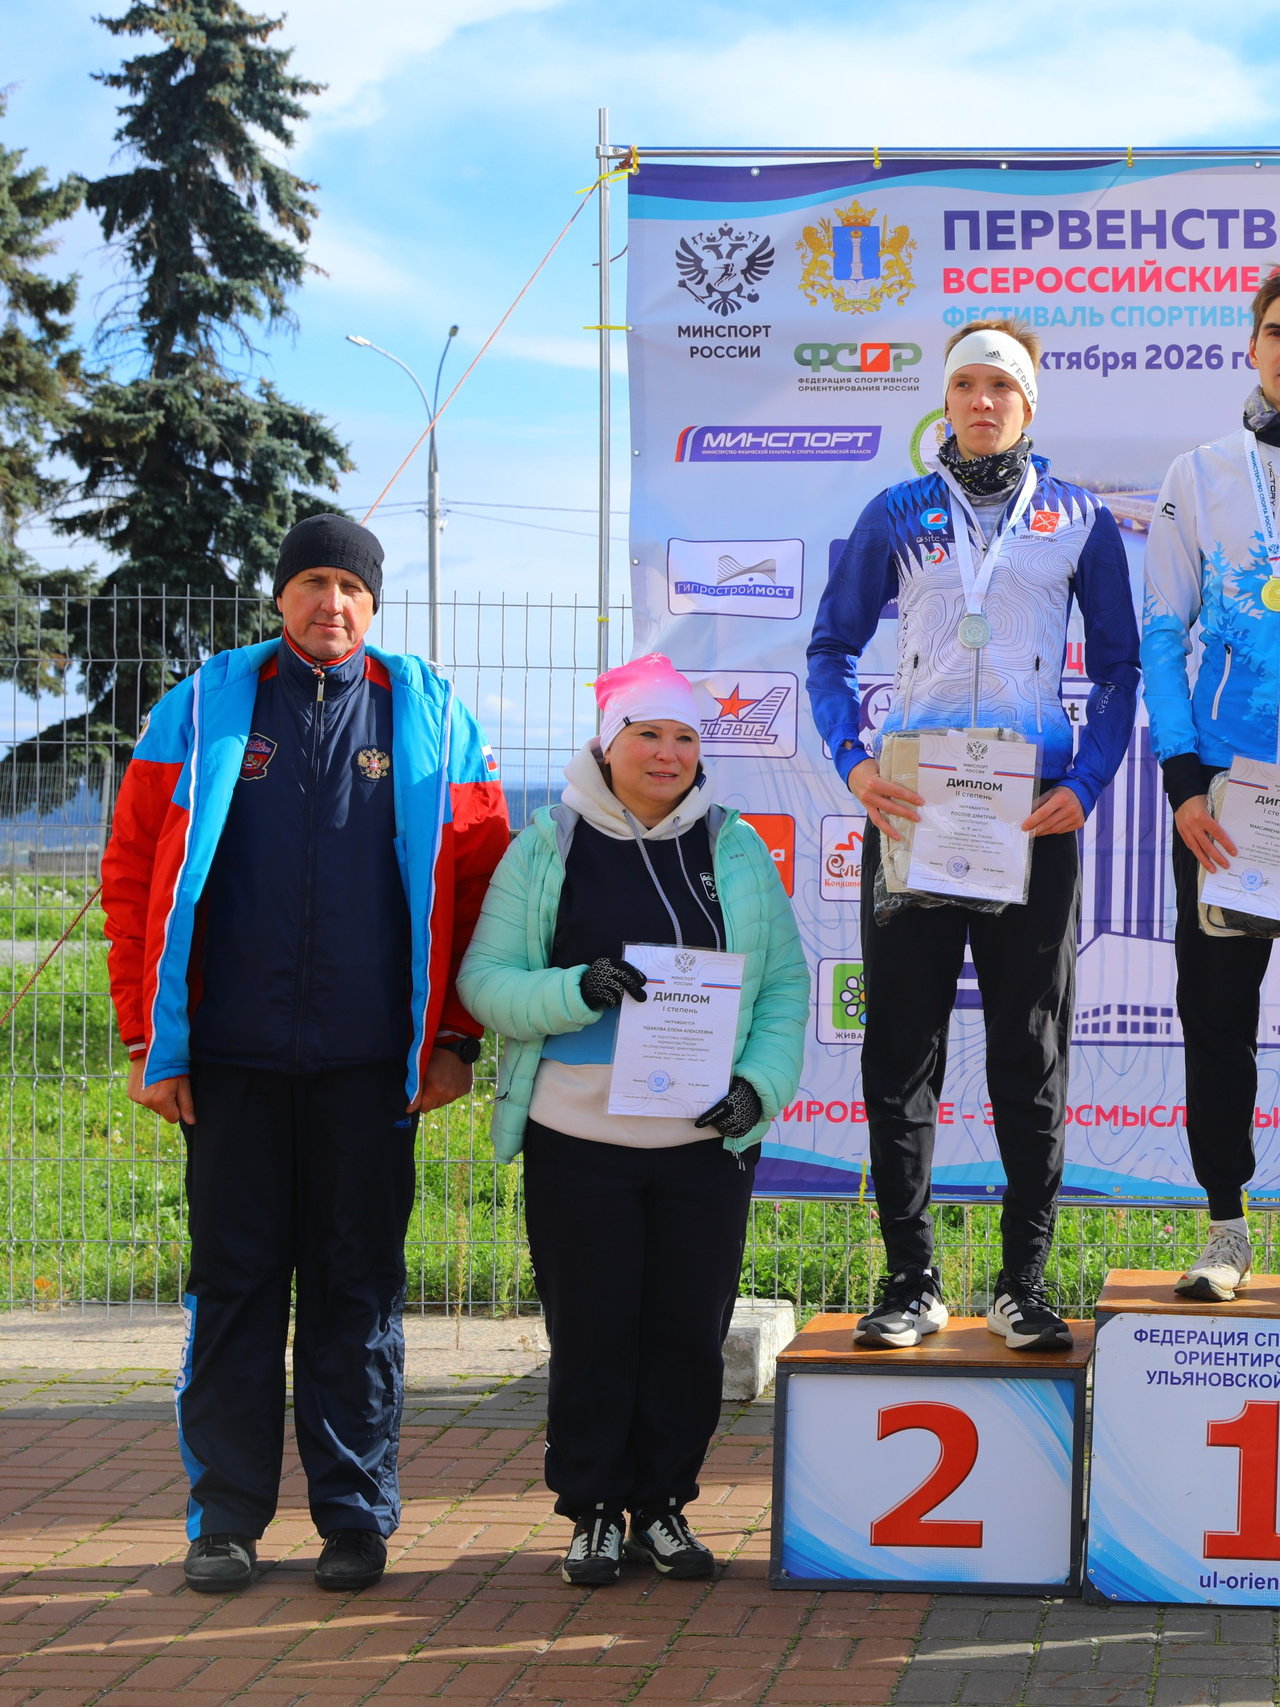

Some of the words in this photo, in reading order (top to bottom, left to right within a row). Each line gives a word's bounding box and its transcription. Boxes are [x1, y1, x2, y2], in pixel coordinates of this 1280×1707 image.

[942, 260, 1260, 294] ВСЕРОССИЙСКИЕ
[677, 325, 772, 338] МИНСПОРТ
[689, 345, 761, 358] РОССИИ
[1146, 344, 1224, 370] 2026
[798, 377, 852, 385] ФЕДЕРАЦИЯ
[854, 377, 920, 385] СПОРТИВНОГО
[1009, 359, 1037, 406] TERREX
[702, 432, 873, 448] МИНСПОРТ
[1250, 450, 1263, 493] МИНИСТЕРСТВО
[1259, 491, 1269, 516] СПОРТА
[1267, 461, 1276, 507] VICTORY
[946, 777, 1003, 792] ДИПЛОМ
[961, 791, 992, 800] степень
[653, 991, 710, 1005] ДИПЛОМ
[666, 1006, 698, 1014] степень
[1133, 1328, 1249, 1347] ФЕДЕРАЦИЯ
[870, 1401, 983, 1548] 2
